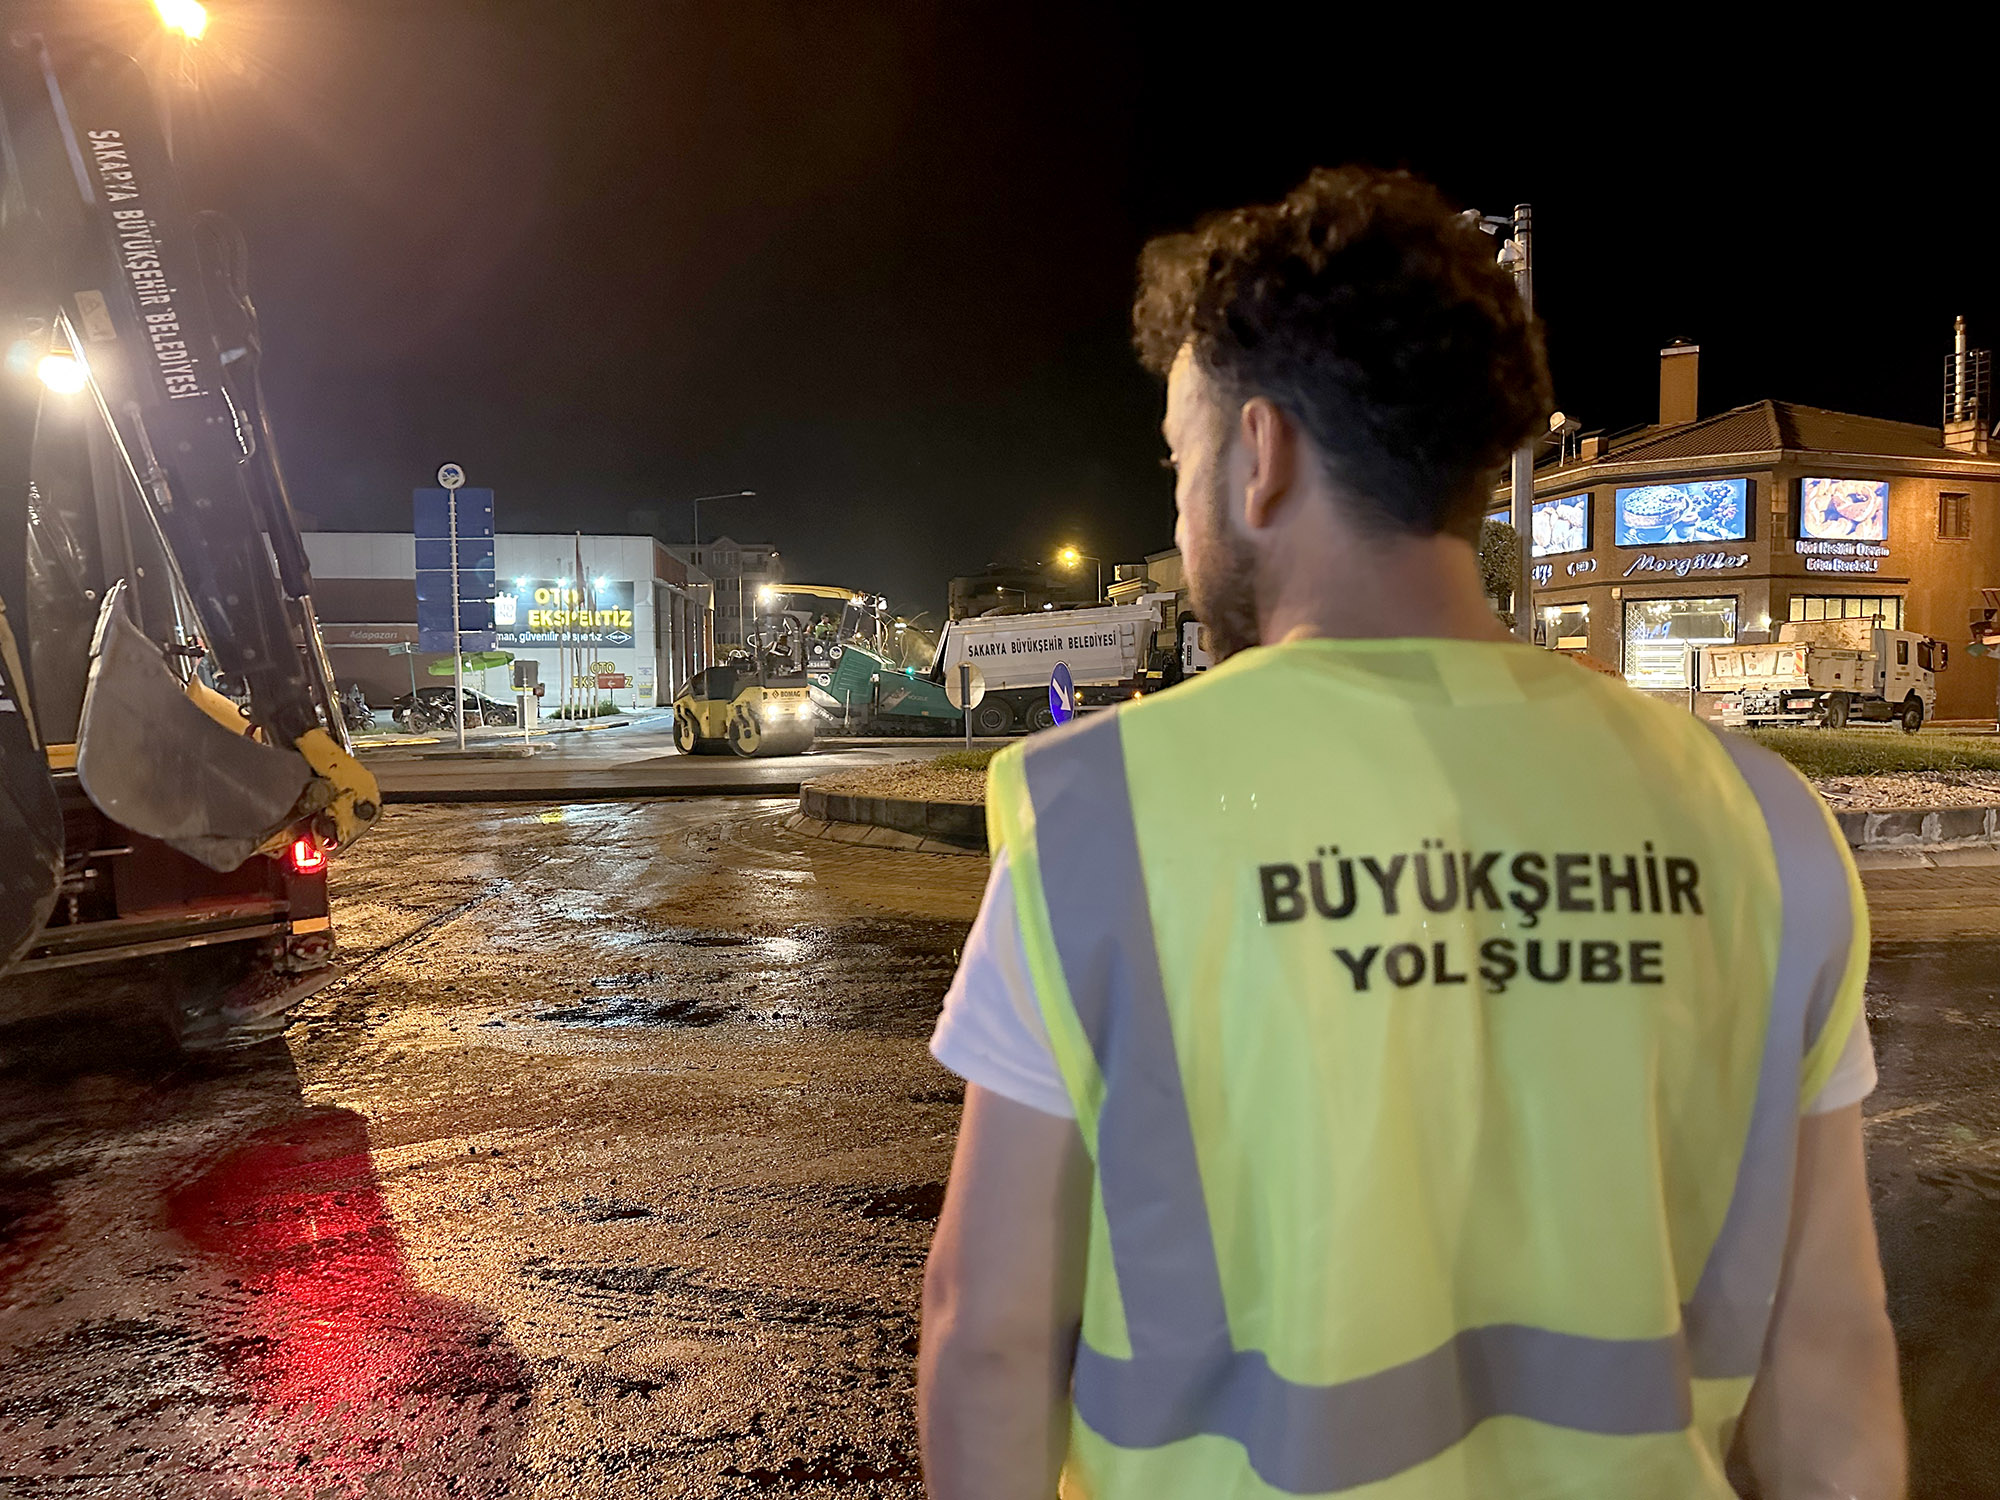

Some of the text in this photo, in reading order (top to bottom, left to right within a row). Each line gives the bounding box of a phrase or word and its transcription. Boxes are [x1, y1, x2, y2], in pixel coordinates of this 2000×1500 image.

[88, 130, 208, 399] SAKARYA BÜYÜKŞEHİR BELEDİYESİ
[534, 588, 579, 605] OTO
[528, 605, 632, 627] EKSPERTİZ
[497, 632, 517, 643] man,
[968, 630, 1117, 657] SAKARYA BÜYÜKŞEHİR BELEDİYESİ
[590, 661, 616, 675] OTO
[1260, 840, 1704, 928] BÜYÜKŞEHİR
